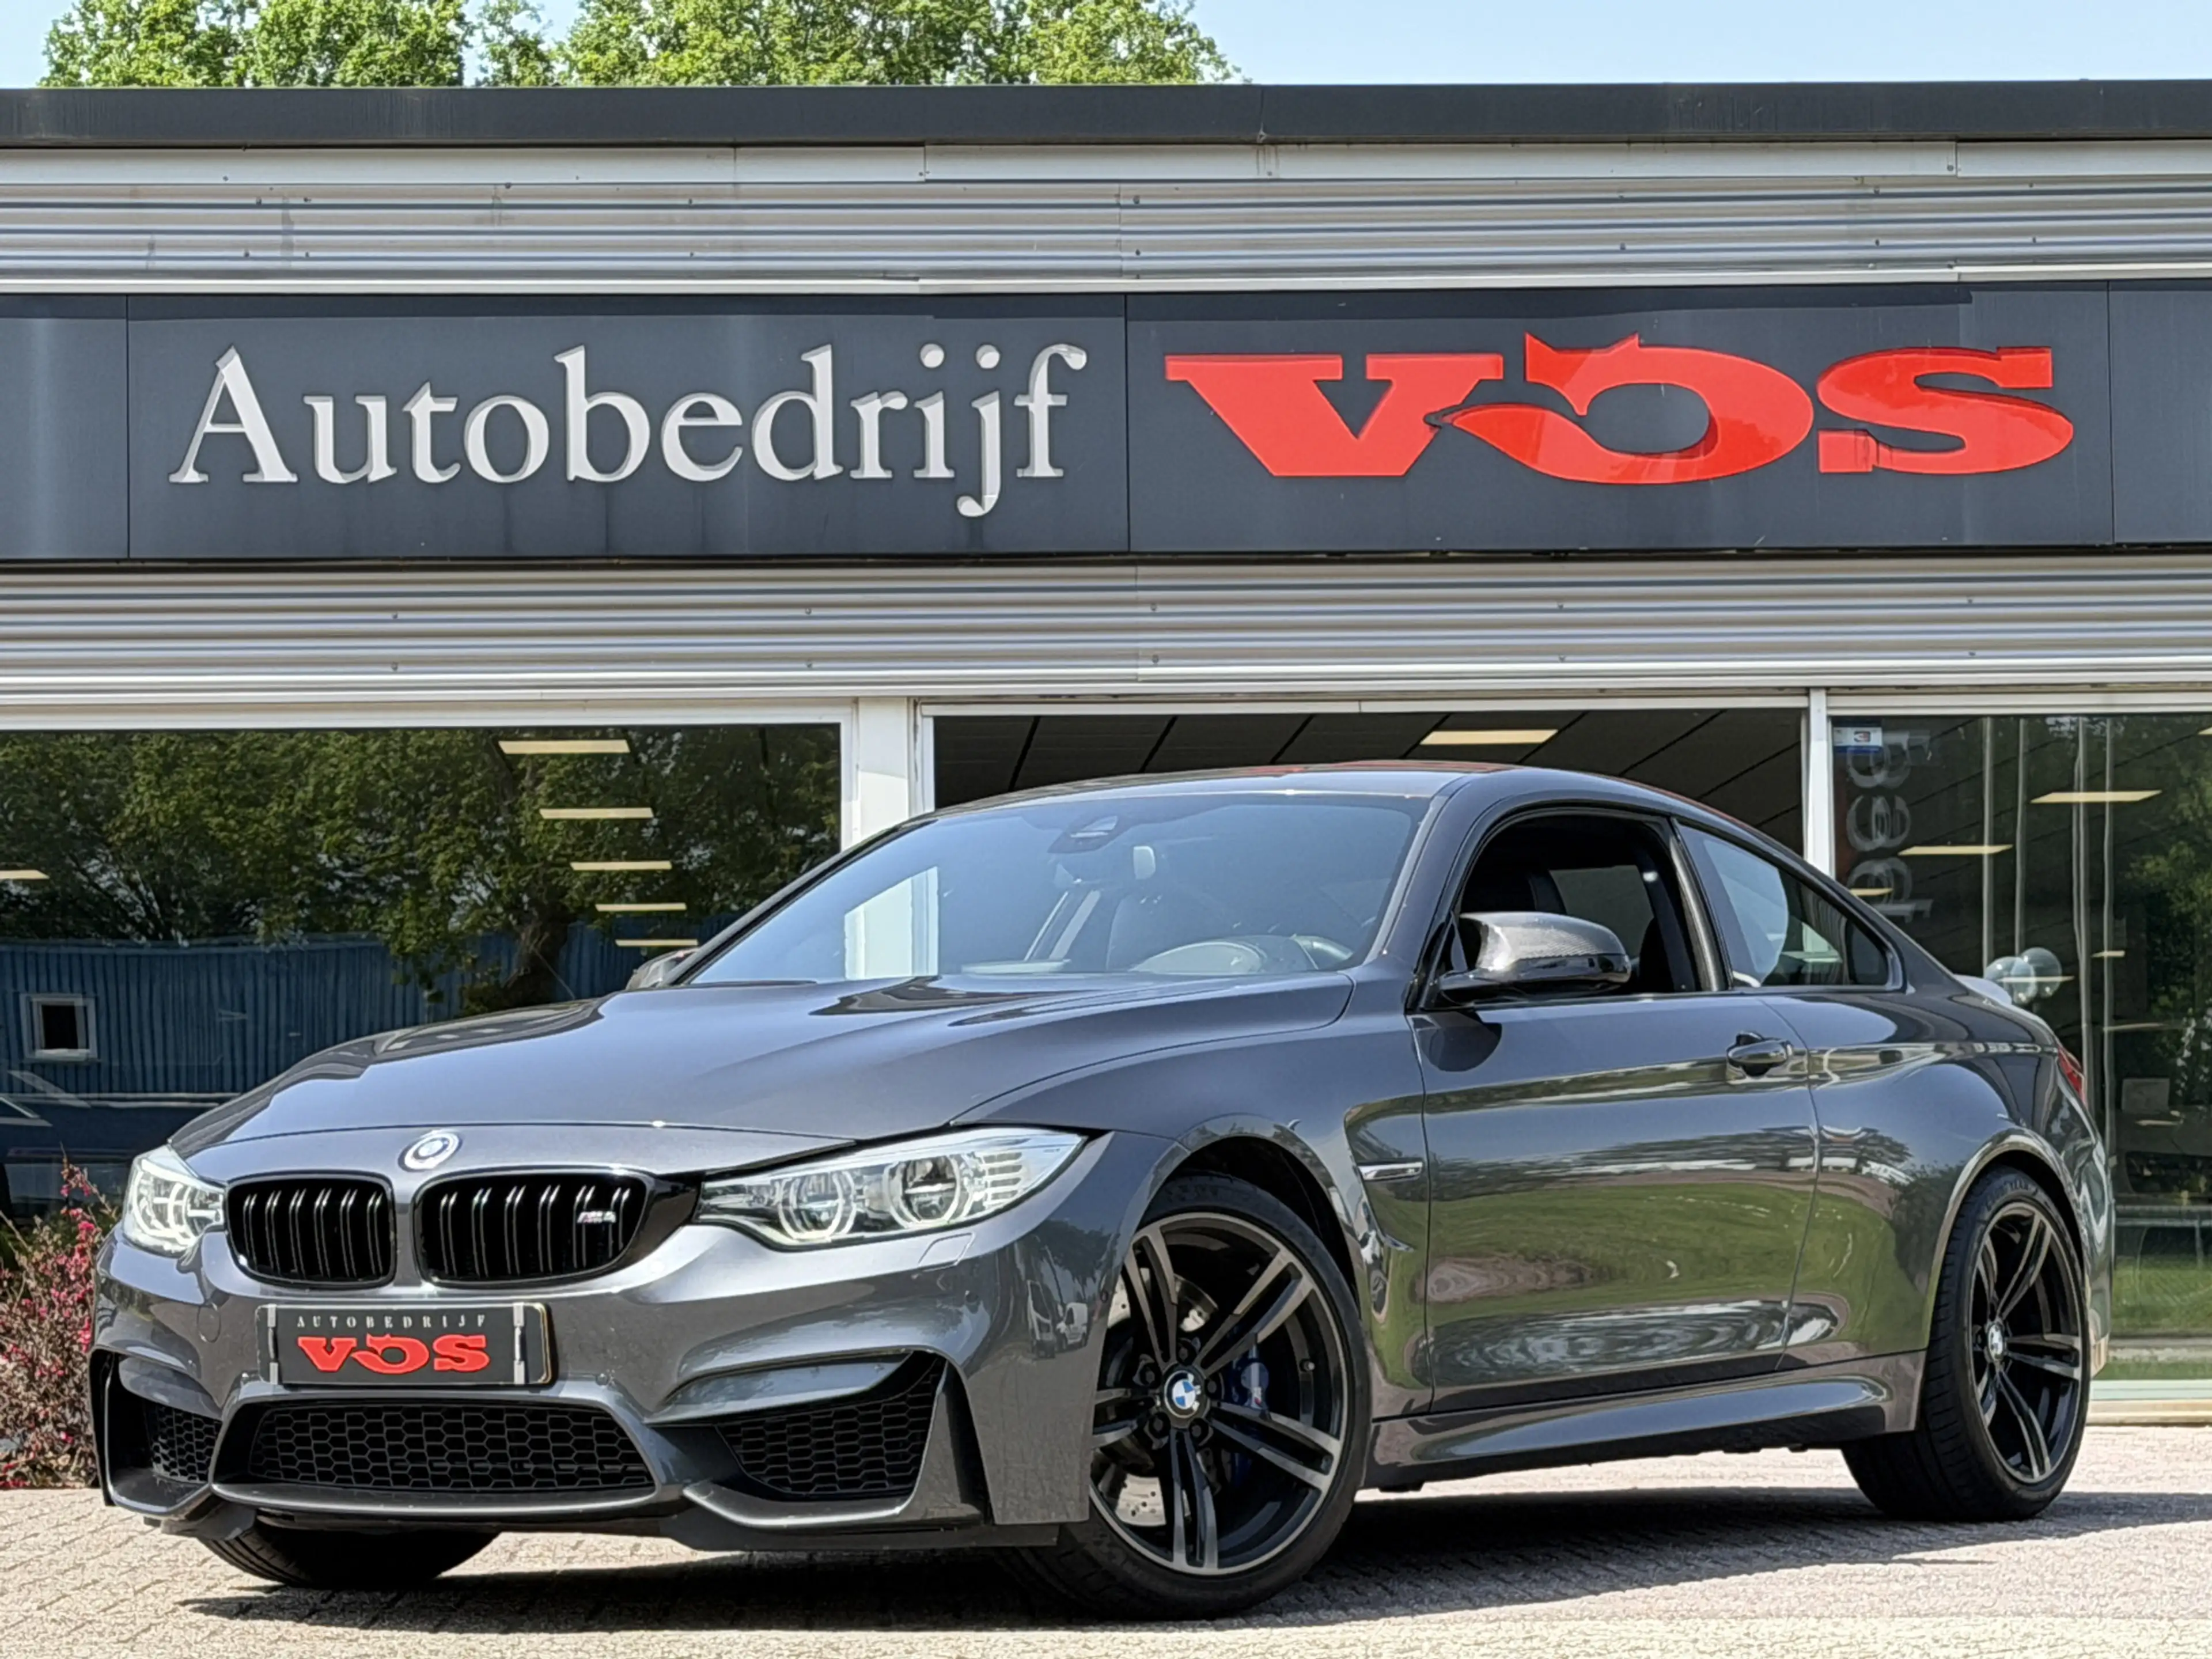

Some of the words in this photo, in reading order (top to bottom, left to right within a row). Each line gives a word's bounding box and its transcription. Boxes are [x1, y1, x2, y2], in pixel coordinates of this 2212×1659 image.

[169, 344, 1088, 518] Autobedrijf
[1164, 332, 2075, 486] VOS
[297, 1314, 486, 1329] AUTOBEDRIJF
[296, 1332, 491, 1375] VOS
